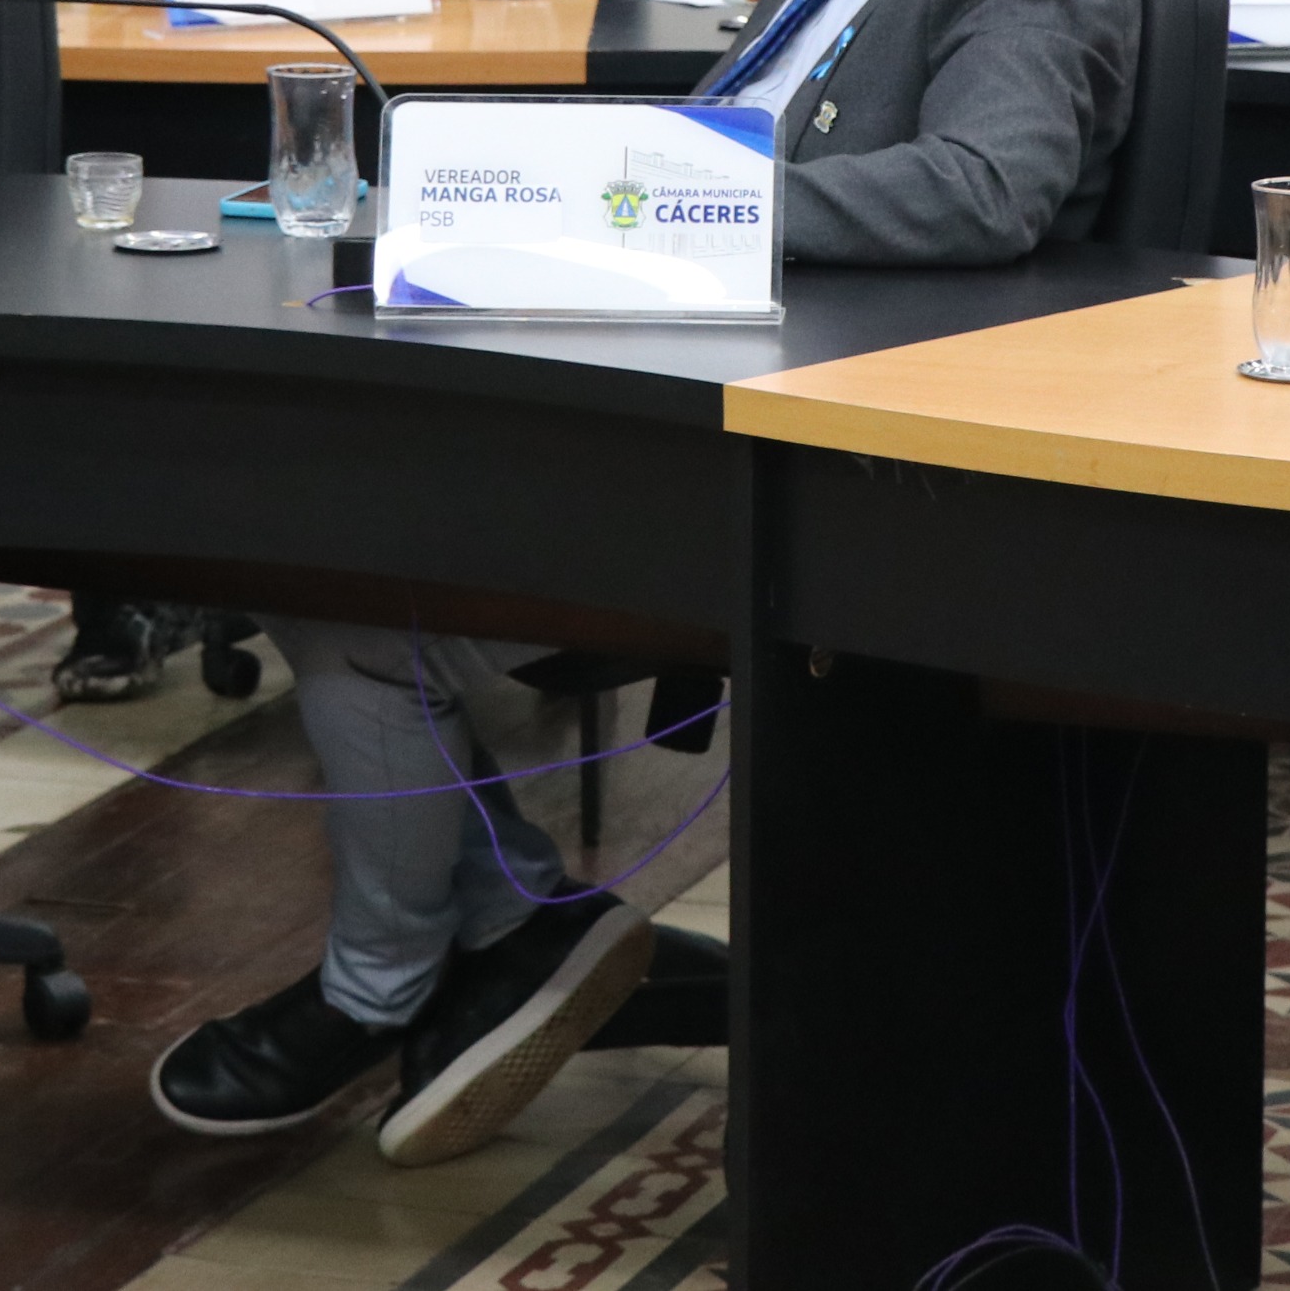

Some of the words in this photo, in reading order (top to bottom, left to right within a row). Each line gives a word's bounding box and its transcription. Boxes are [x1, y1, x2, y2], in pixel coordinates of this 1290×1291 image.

[424, 169, 521, 185] VEREADOR
[420, 187, 497, 203] MANGA
[504, 187, 562, 203] ROSA
[652, 186, 699, 199] CÂMARA
[702, 188, 763, 199] MUNICIPAL
[420, 211, 455, 227] PSB
[655, 199, 760, 224] CÁCERES
